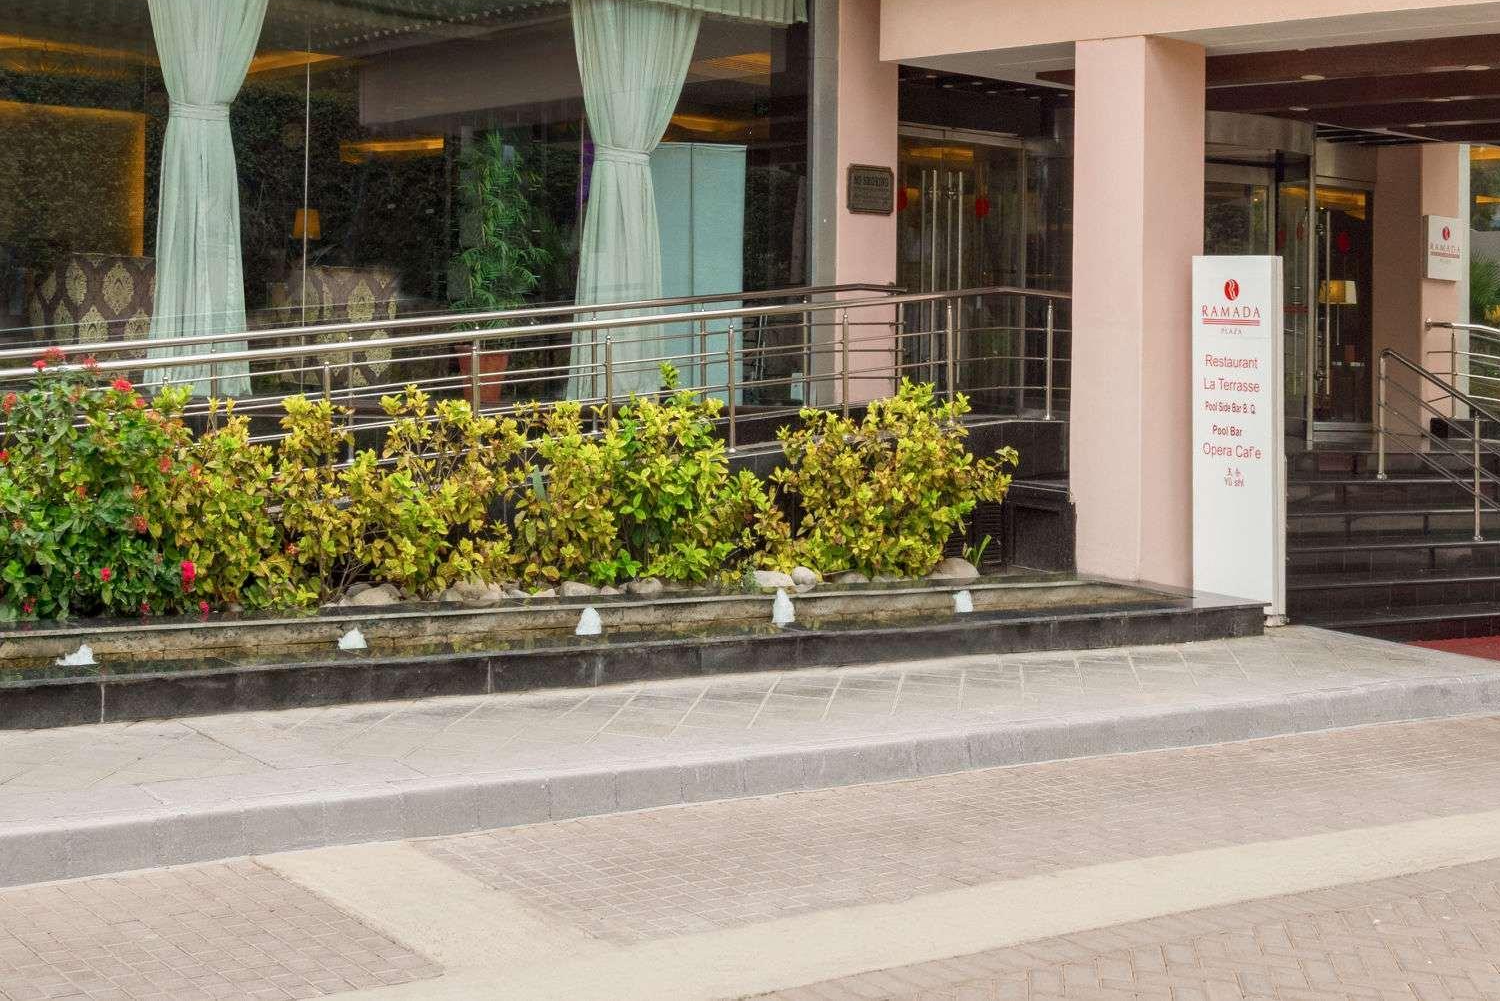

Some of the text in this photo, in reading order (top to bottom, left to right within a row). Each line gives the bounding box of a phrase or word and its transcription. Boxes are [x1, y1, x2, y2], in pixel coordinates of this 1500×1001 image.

[1202, 304, 1260, 318] RAMADA
[1205, 353, 1258, 369] Restaurant
[1203, 376, 1260, 393] La Terrasse
[1205, 401, 1218, 412] Pool
[1219, 402, 1231, 413] Side
[1212, 424, 1243, 437] Pool Bar
[1203, 442, 1232, 458] Opera
